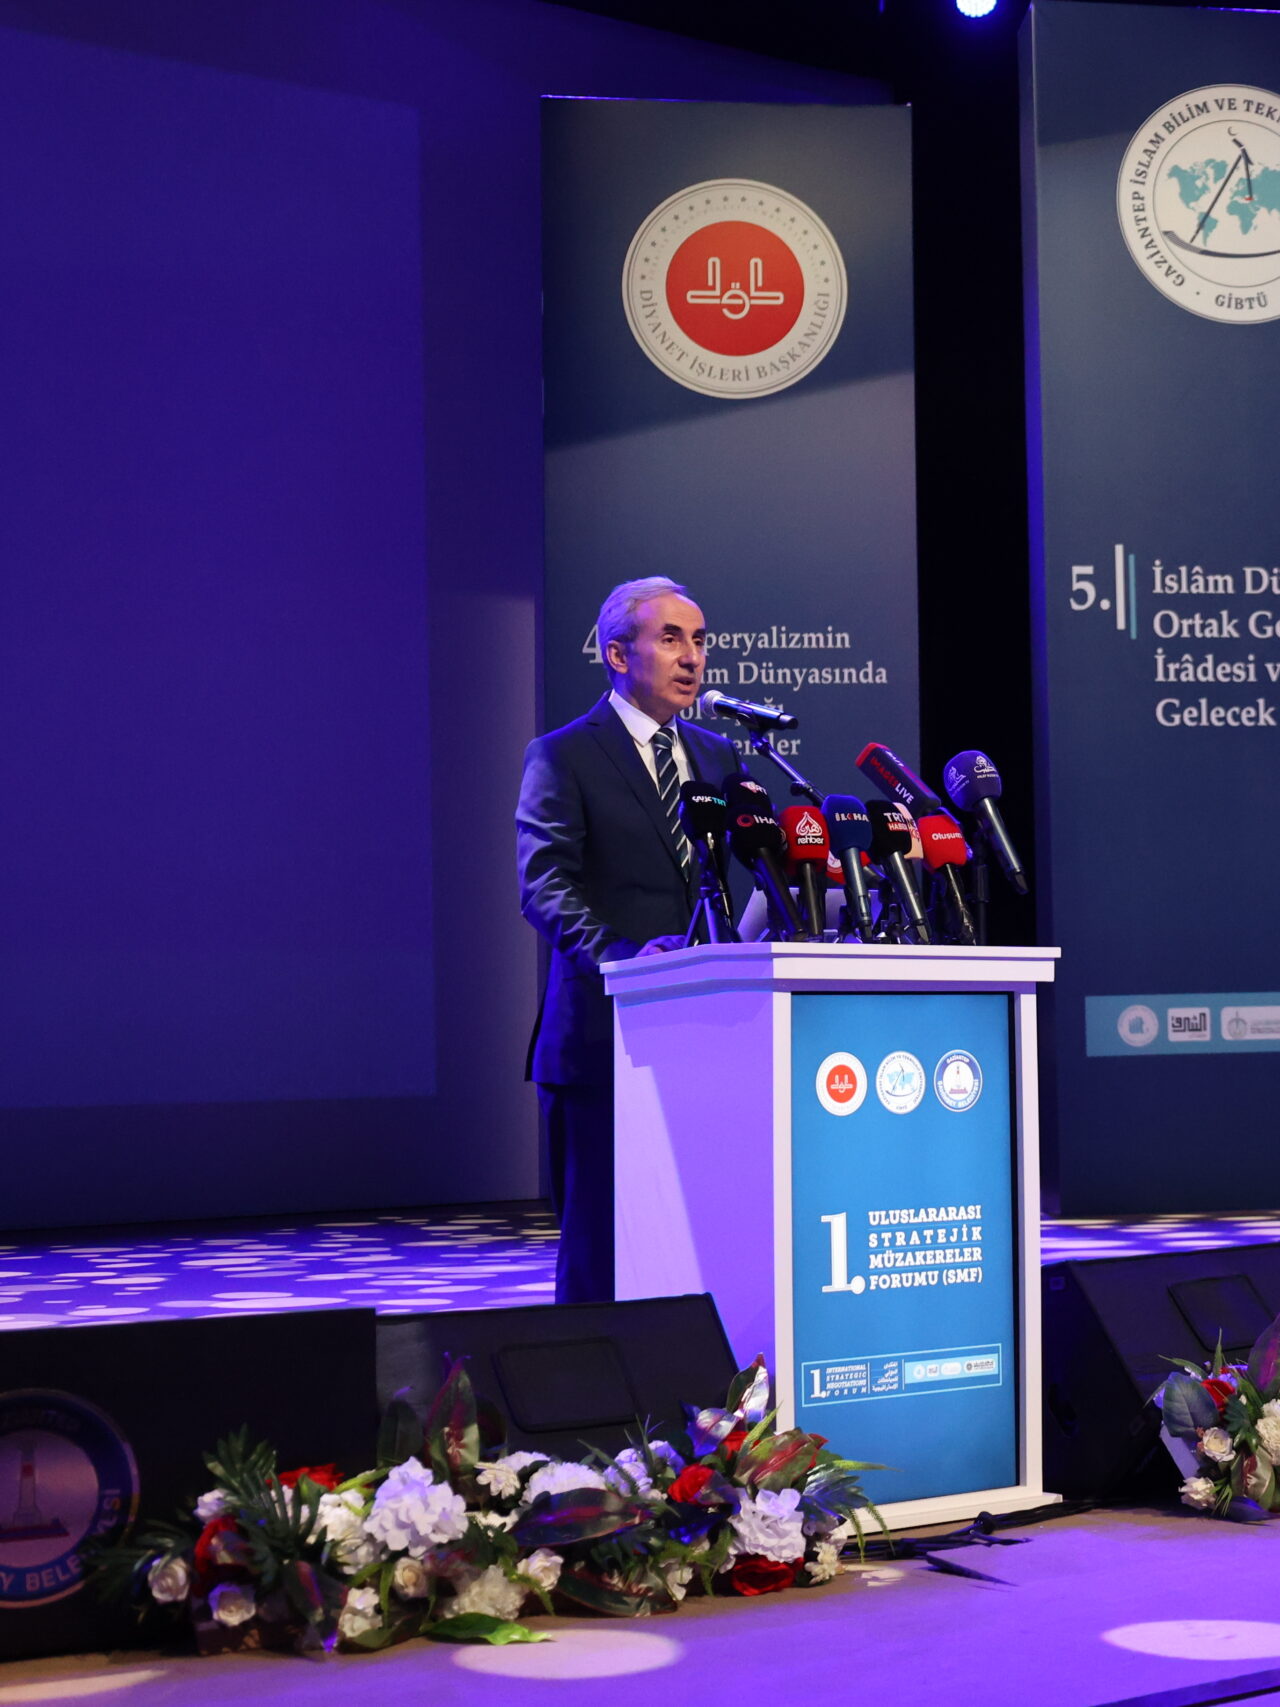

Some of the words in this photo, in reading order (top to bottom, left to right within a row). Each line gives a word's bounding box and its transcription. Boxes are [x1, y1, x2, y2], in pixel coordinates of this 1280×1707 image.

[1162, 100, 1211, 135] BİLİM
[1214, 98, 1237, 111] VE
[1130, 131, 1166, 187] İSLAM
[1132, 191, 1185, 287] GAZİANTEP
[1215, 292, 1269, 311] GİBTÜ
[640, 289, 689, 363] DİYANET
[690, 356, 750, 382] İŞLERİ
[756, 291, 831, 379] BAŞKANLIĞI
[1070, 565, 1111, 611] 5.
[1153, 559, 1235, 595] İslâm
[1153, 610, 1239, 638] Ortak
[704, 626, 851, 657] peryalizmin
[738, 661, 888, 692] Dünyasında
[1154, 648, 1257, 682] İrâdesi
[1155, 698, 1277, 727] Gelecek
[894, 782, 915, 805] LIVE
[797, 836, 824, 845] rehber
[868, 1205, 982, 1226] ULUSLARARASI
[868, 1226, 982, 1248] STRATEJİK
[820, 1211, 866, 1295] 1.
[869, 1246, 983, 1269] MÜZAKERELER
[870, 1269, 940, 1290] FORUMU
[942, 1267, 983, 1287] (SMF)
